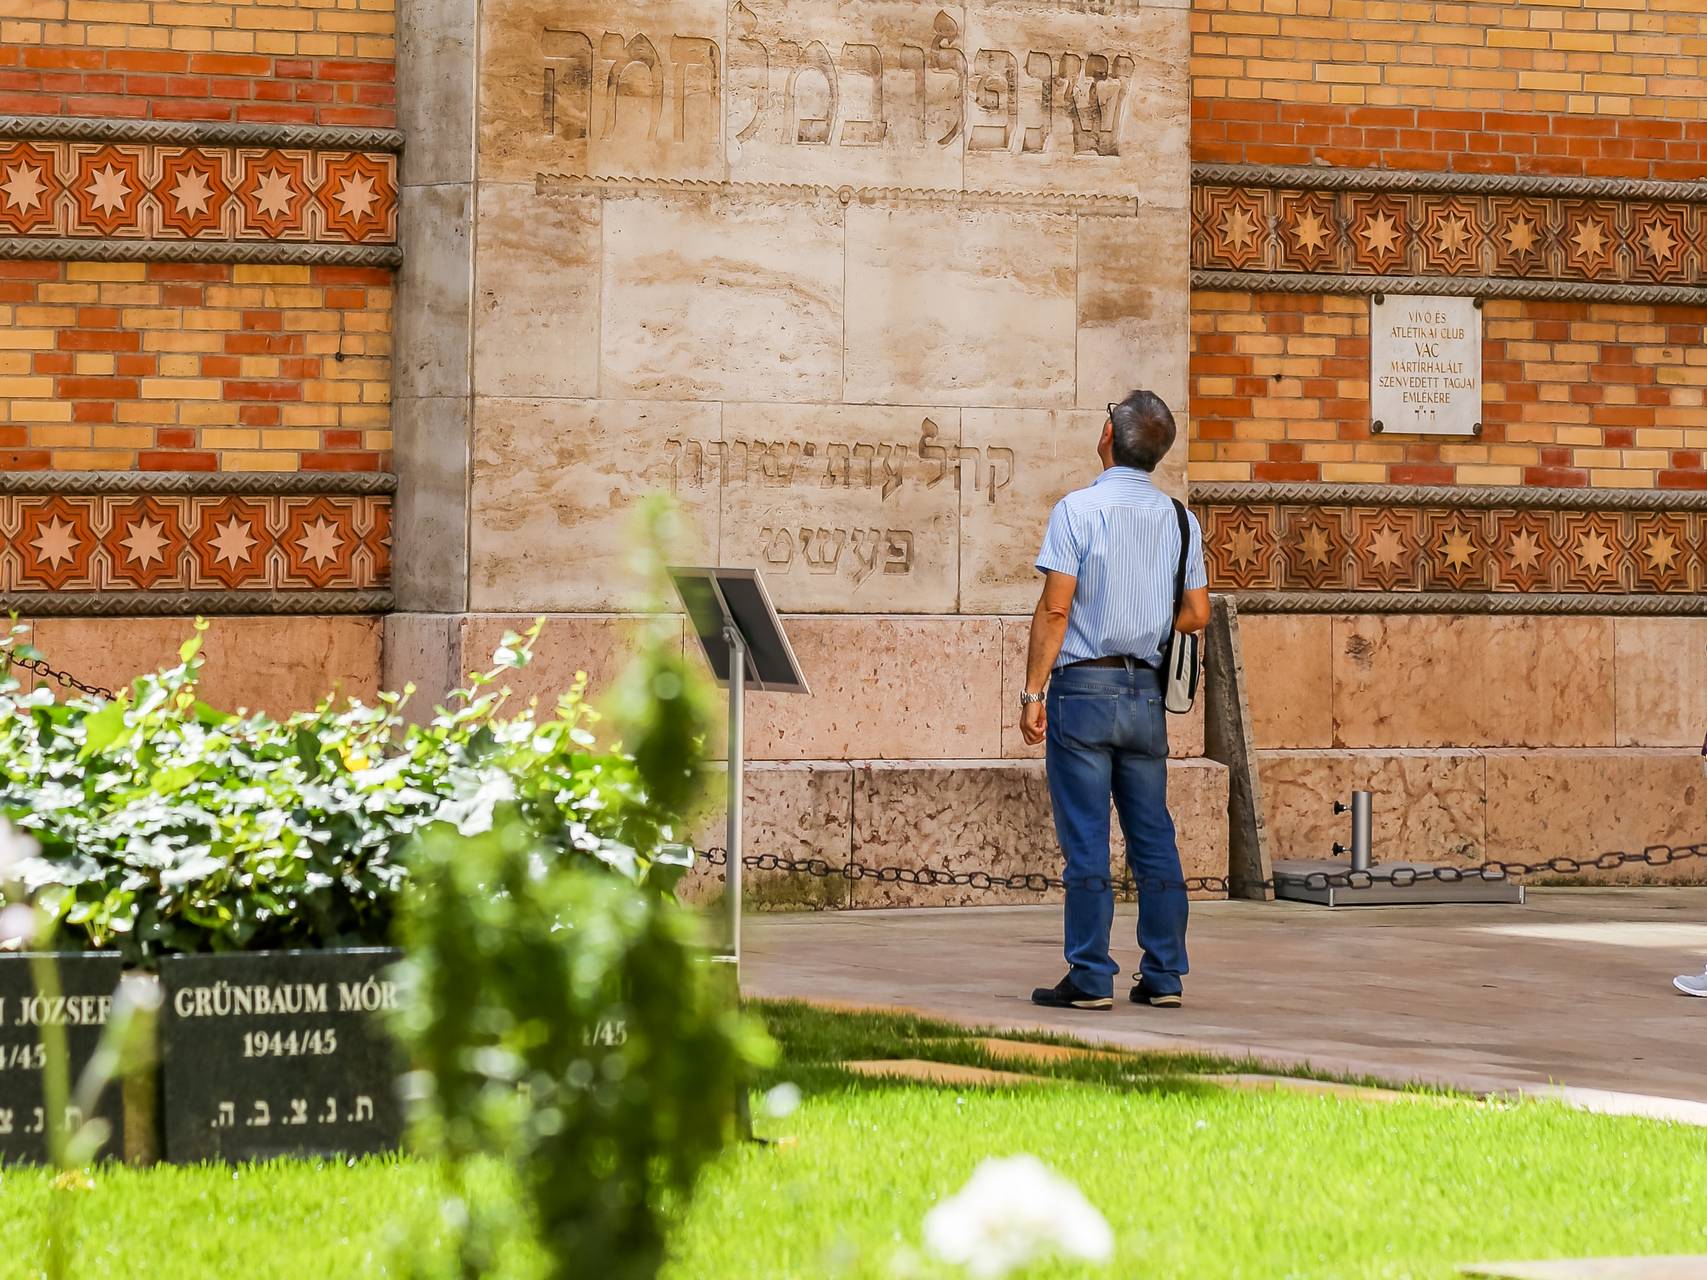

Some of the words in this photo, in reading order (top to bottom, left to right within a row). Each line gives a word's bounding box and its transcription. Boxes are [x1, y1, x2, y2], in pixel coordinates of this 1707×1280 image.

[541, 0, 888, 148] במלחמה
[900, 9, 1136, 158] שנפלו
[1435, 310, 1447, 324] ÉS
[1441, 328, 1465, 340] CLUB
[1415, 342, 1440, 358] VAC
[1379, 376, 1440, 388] SZENVEDETT
[1444, 377, 1475, 390] TAGJAI
[1402, 389, 1451, 404] EMLÉKÉRE
[664, 437, 817, 497] ישורון
[820, 441, 908, 503] עדת
[918, 416, 1015, 505] קהל
[758, 526, 915, 594] פעשט
[15, 990, 113, 1026] JÓZSEF
[174, 980, 328, 1018] GRÜNBAUM
[337, 974, 399, 1012] MÓR
[242, 1028, 338, 1058] 1944/45
